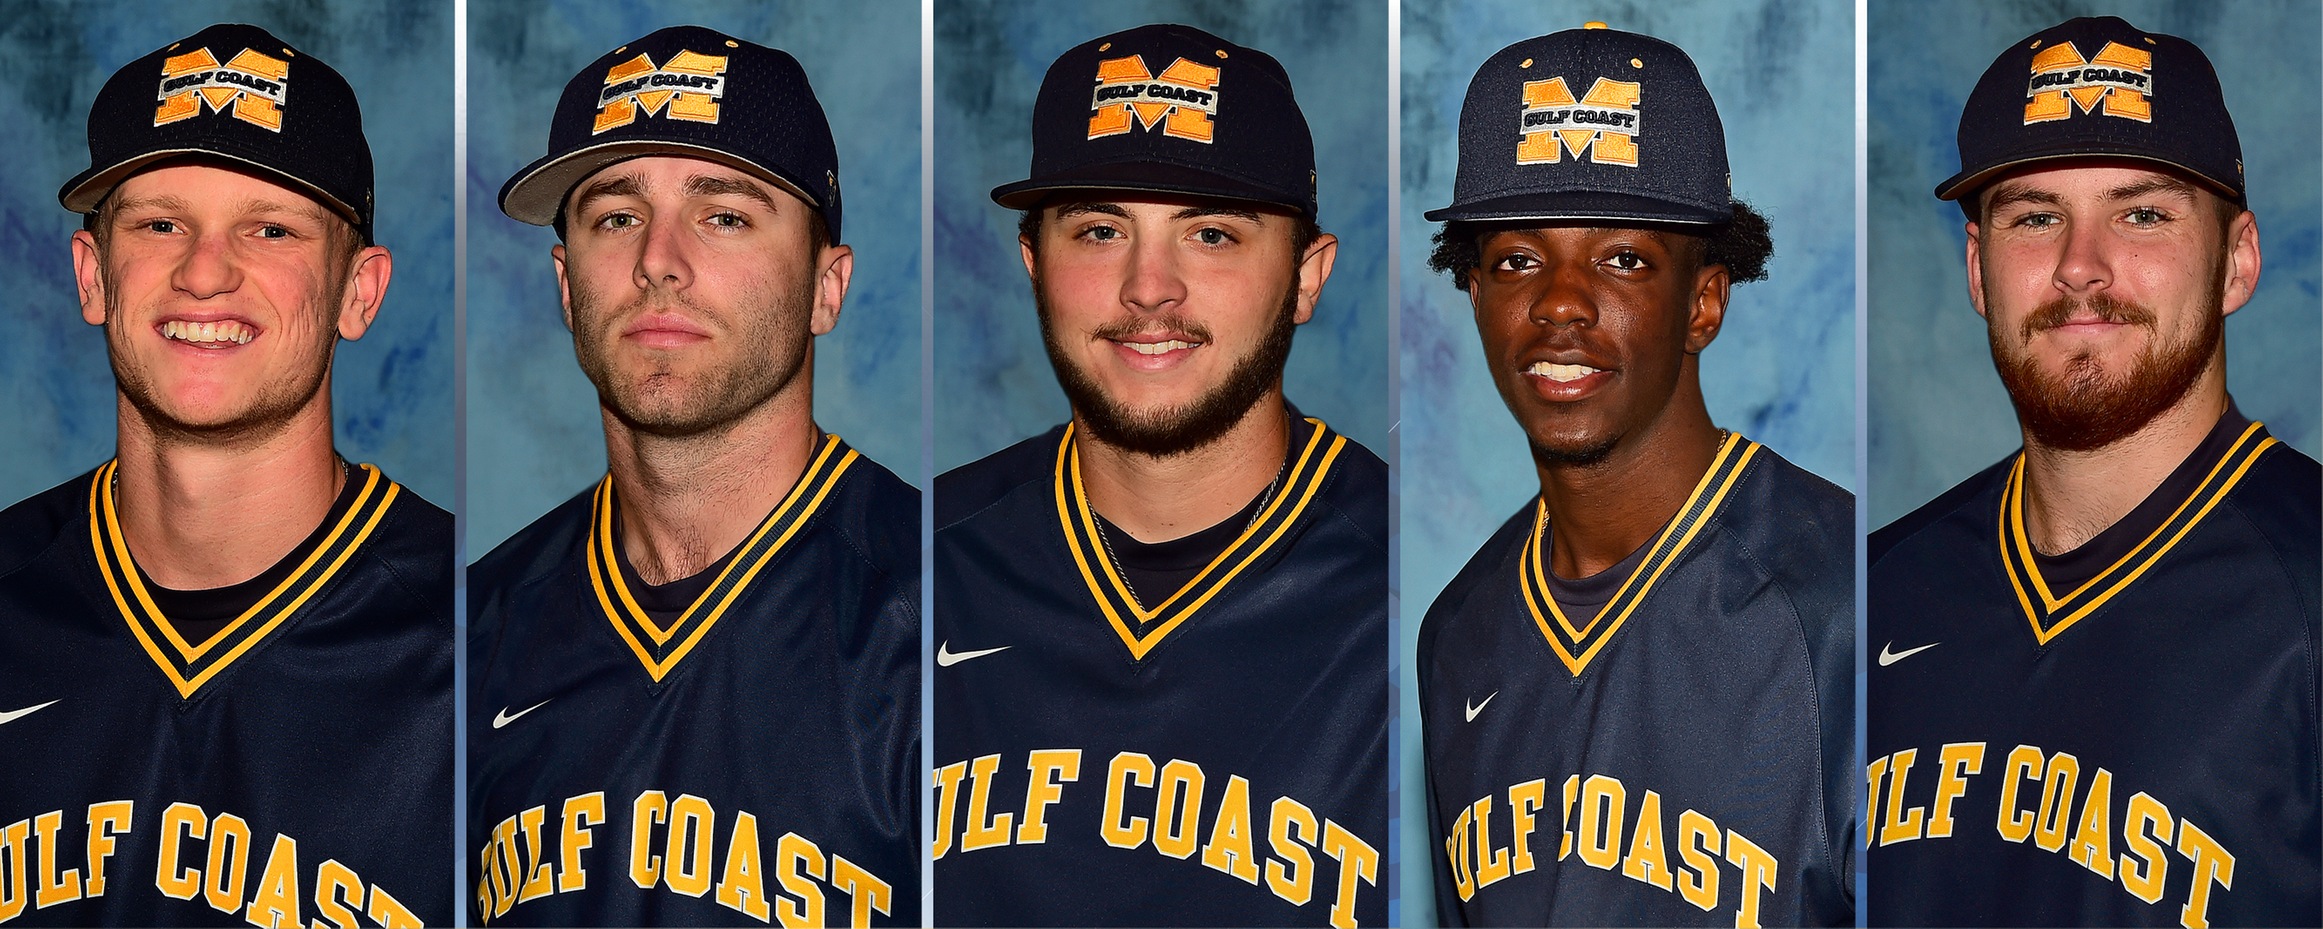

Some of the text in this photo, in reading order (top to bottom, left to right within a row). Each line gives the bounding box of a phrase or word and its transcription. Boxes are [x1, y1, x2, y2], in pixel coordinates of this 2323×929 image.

[164, 71, 282, 97] GULF COAST
[603, 73, 719, 100] GULF COAST
[2031, 68, 2148, 89] GULF COAST
[1097, 84, 1213, 106] GULF COAST
[1524, 109, 1636, 128] GULF COAST
[1100, 751, 1380, 928] COAST
[1446, 778, 1546, 903] ULF
[1996, 743, 2236, 928] COAST
[628, 790, 893, 928] COAST
